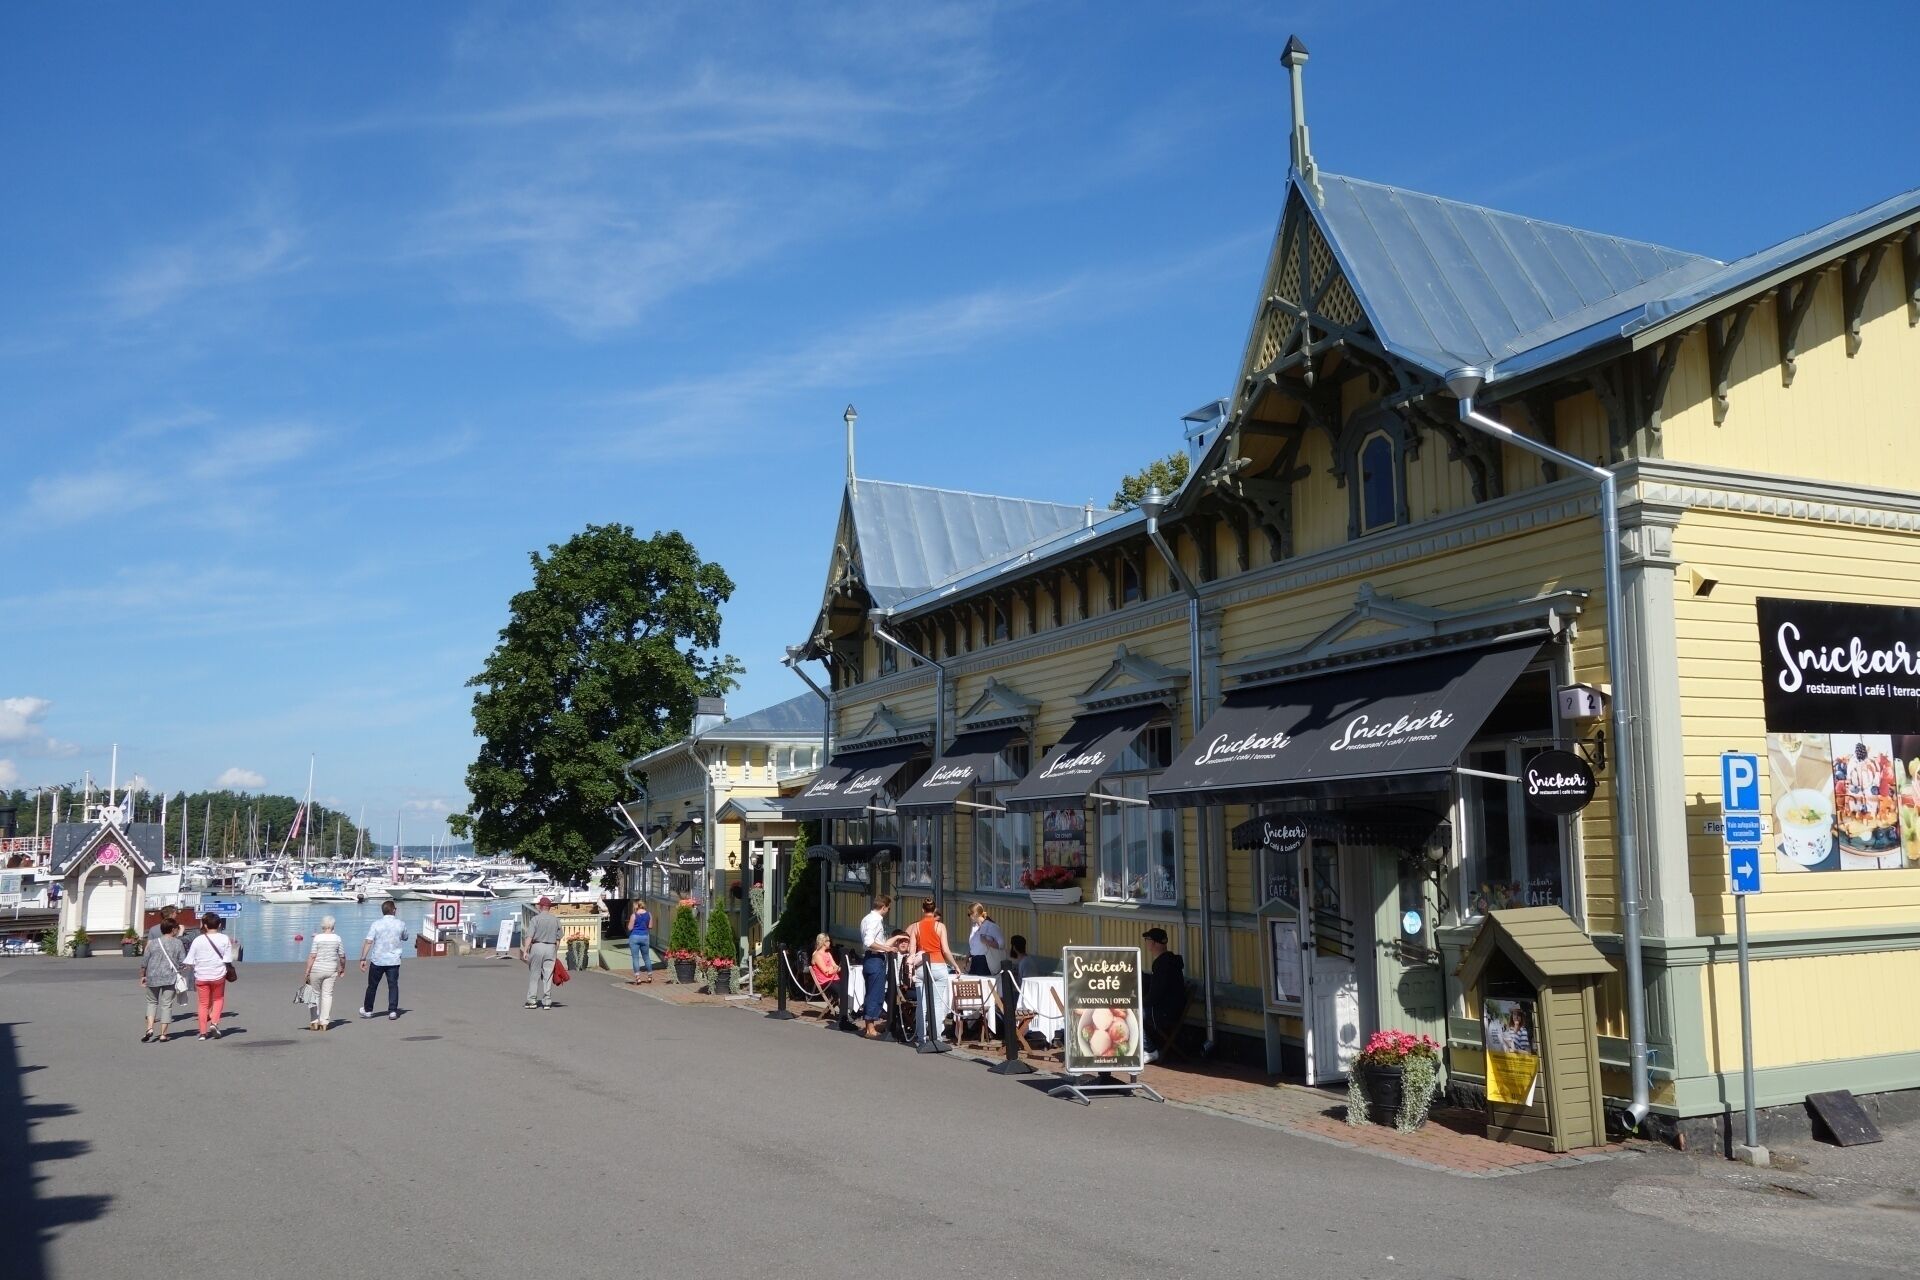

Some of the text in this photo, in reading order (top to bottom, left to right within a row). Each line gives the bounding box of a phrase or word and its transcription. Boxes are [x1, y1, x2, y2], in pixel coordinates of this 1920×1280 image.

[1806, 683, 1920, 697] restaurant café terrac
[1586, 694, 1596, 709] 2
[1330, 709, 1454, 751] Snickari
[1194, 732, 1291, 766] Snickari
[1345, 734, 1437, 751] restaurant café terrace
[1040, 751, 1106, 779] Snickari
[1528, 769, 1587, 795] Snickari
[1729, 758, 1753, 807] P
[1263, 822, 1305, 845] Snickari
[1285, 840, 1301, 852] bakery
[37, 869, 49, 877] S/
[1524, 887, 1552, 905] CAFÉ
[440, 905, 455, 920] 10
[1073, 956, 1133, 979] Snickari
[1088, 976, 1120, 990] café
